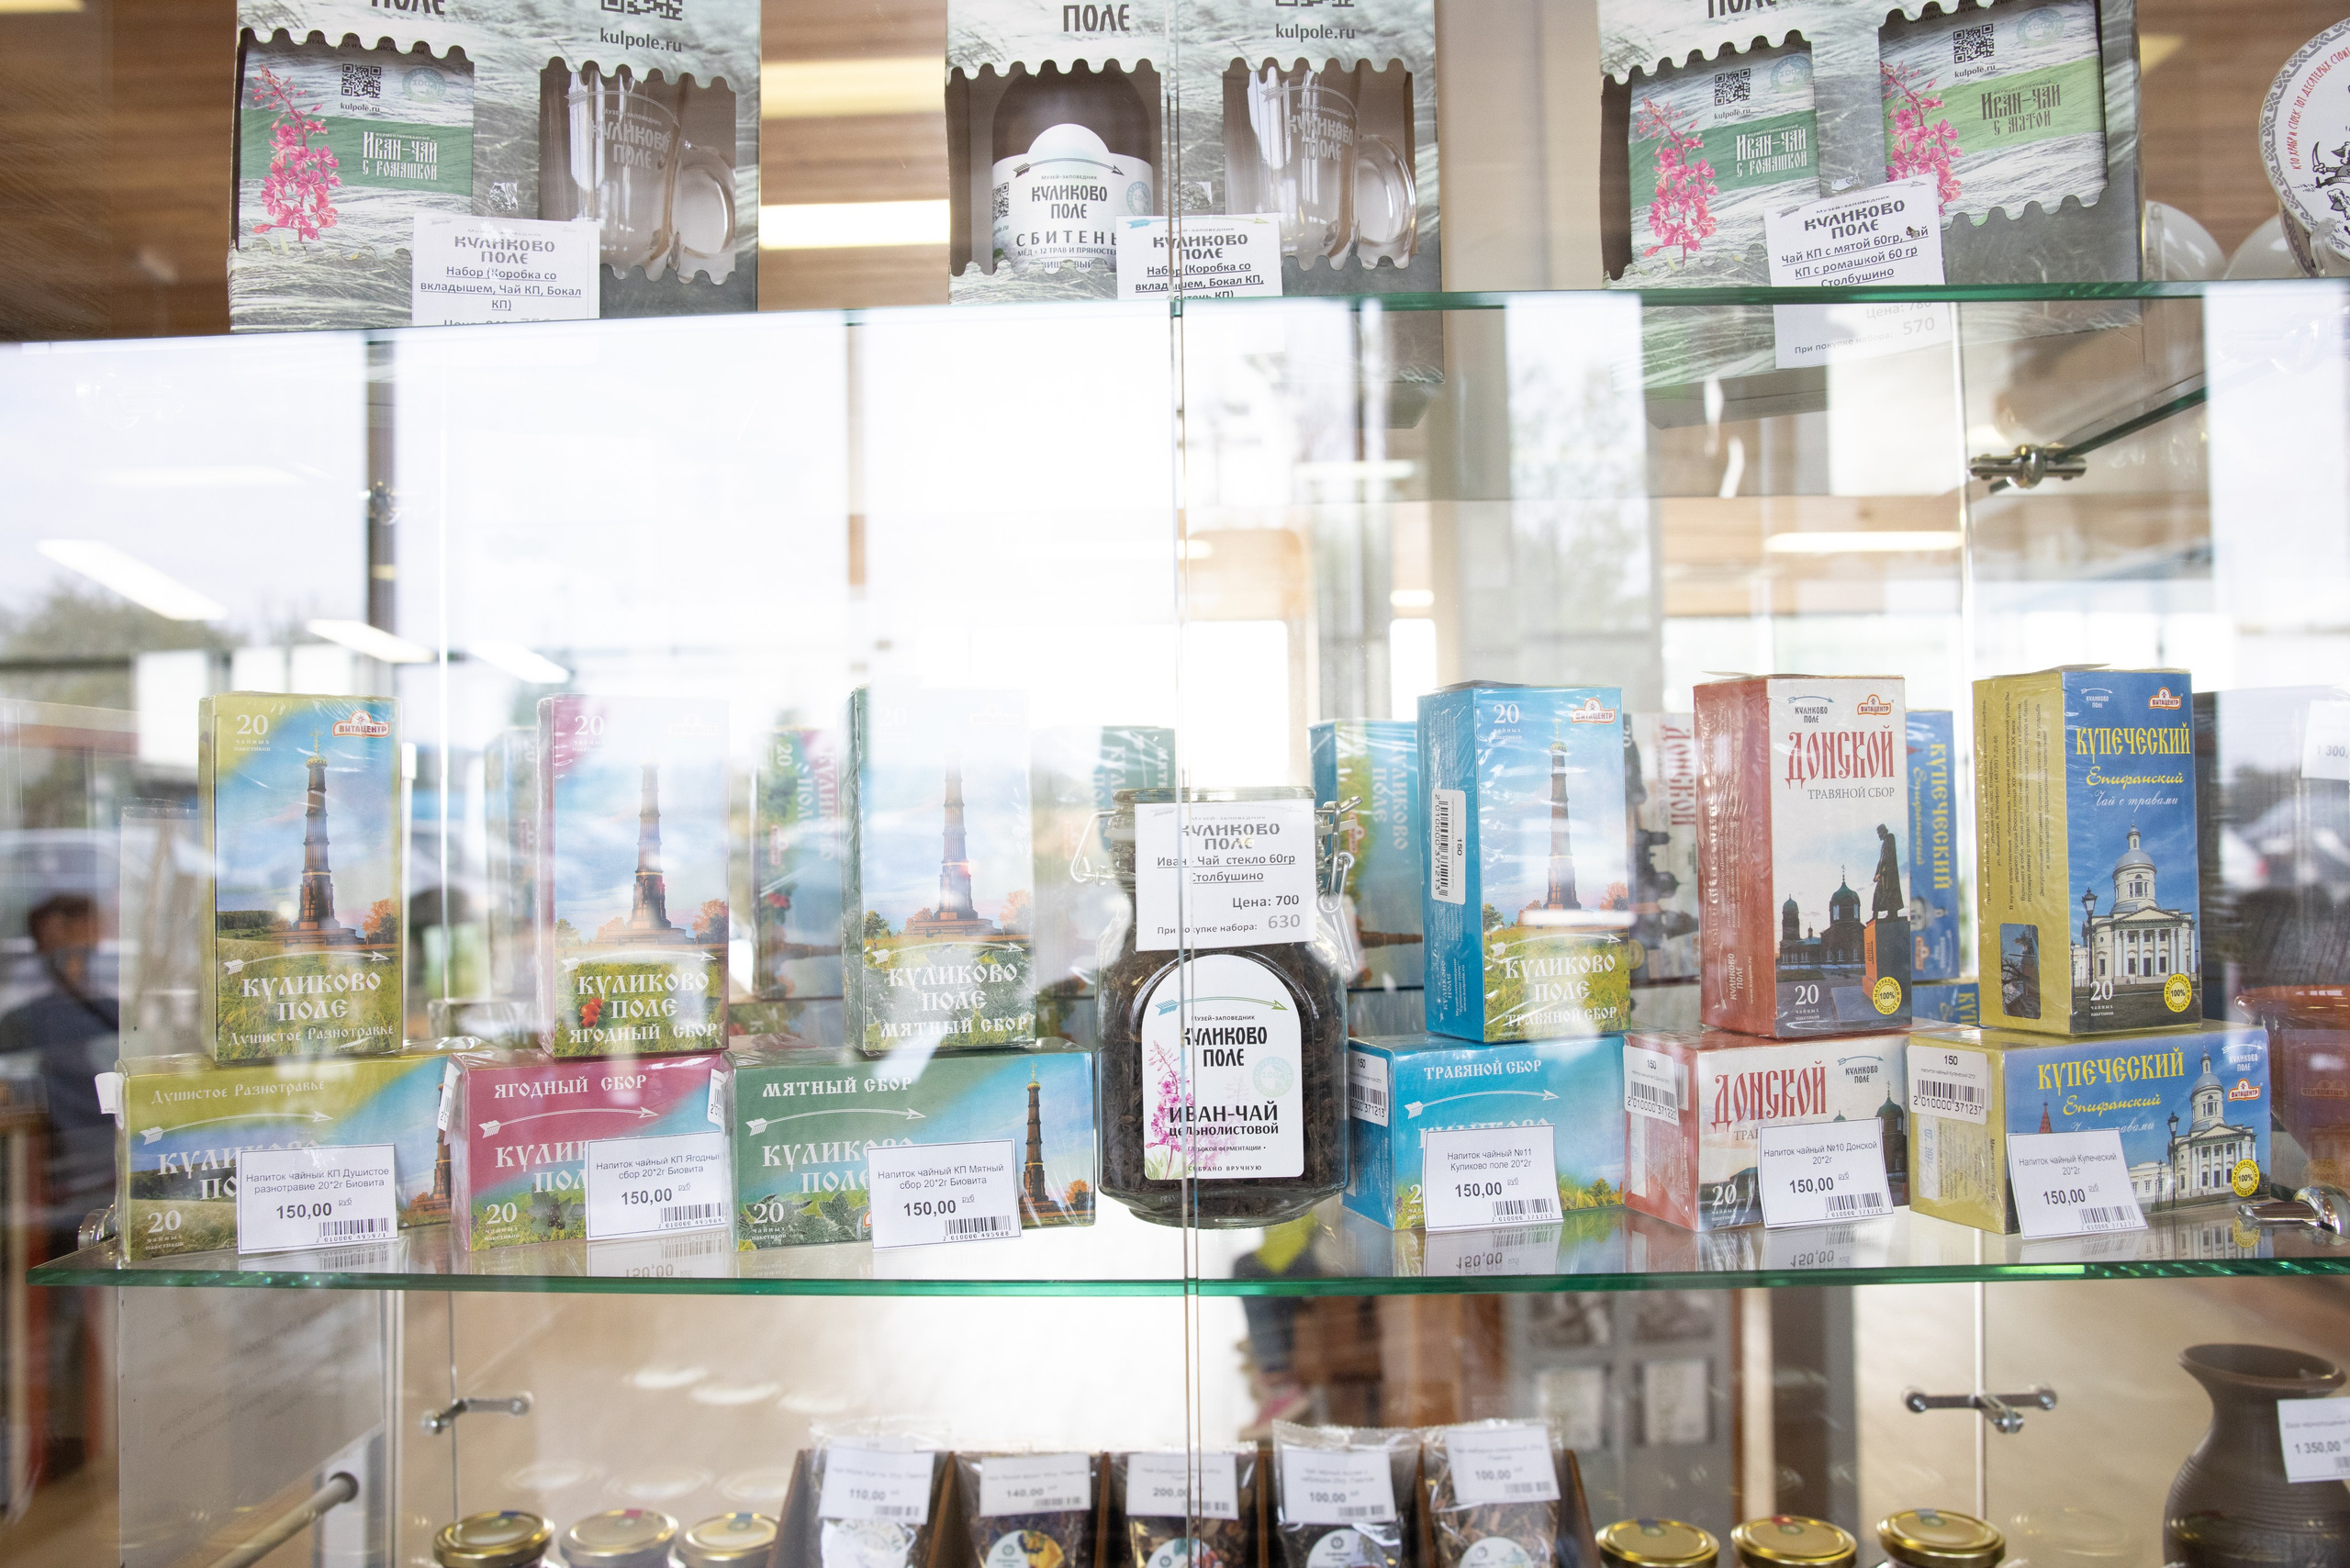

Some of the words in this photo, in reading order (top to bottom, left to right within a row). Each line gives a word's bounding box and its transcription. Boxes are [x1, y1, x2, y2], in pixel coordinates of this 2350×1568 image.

[1062, 5, 1130, 32] ПОЛЕ
[600, 28, 681, 52] kulpole.ru
[1276, 24, 1355, 42] kulpole.ru
[1954, 64, 1996, 78] kulpole.ru
[341, 103, 380, 112] kulpole.ru
[2294, 95, 2307, 107] ТОТ
[2287, 137, 2299, 156] ХРАБР
[2290, 156, 2301, 169] КТО
[1032, 185, 1107, 201] КУЛИКОВО
[1051, 204, 1087, 218] ПОЛЕ
[1804, 200, 1905, 230] КУЛИКОВО
[1831, 219, 1879, 239] ПОЛЕ
[454, 236, 555, 252] КУЛИКОВО
[1782, 253, 1803, 264] Чай
[1807, 249, 1822, 259] КП
[1834, 239, 1870, 254] мятой
[1874, 235, 1903, 246] 60гр,
[481, 252, 528, 263] ПОЛЕ
[1823, 252, 1886, 273] ромашкой
[1889, 249, 1902, 259] 60
[1906, 246, 1918, 258] гр
[446, 266, 483, 277] Набор
[544, 272, 556, 280] со
[1185, 264, 1235, 274] (Коробка
[1821, 268, 1894, 286] Столбушино
[420, 283, 496, 294] вкладышем,
[499, 285, 520, 295] Чай
[525, 286, 543, 296] КП,
[547, 286, 581, 296] Бокал
[1209, 278, 1242, 286] Бокал
[1246, 275, 1264, 284] КП,
[492, 300, 511, 310] КП)
[1903, 318, 1935, 336] 570
[1494, 704, 1519, 724] 20
[1795, 706, 1829, 715] КУЛИКОВО
[1860, 705, 1890, 713] ВИТАЦЕНТР
[237, 714, 268, 734] 20
[1804, 714, 1819, 723] ПОЛЕ
[339, 724, 387, 734] ВИТАЦЕНТР
[2076, 722, 2190, 764] КУПЕЧЕСКИЙ
[1785, 725, 1895, 790] ДОНСКОЙ
[2087, 767, 2185, 788] Епифанский
[1807, 786, 1865, 801] ТРАВЯНОЙ
[1868, 786, 1895, 798] СБОР
[2128, 795, 2178, 812] травами
[1197, 856, 1219, 865] Чай
[1226, 856, 1266, 865] стекло
[1269, 854, 1295, 865] 60гр
[1232, 896, 1271, 909] Цена:
[1276, 895, 1300, 906] 700
[1220, 924, 1258, 933] набора:
[1268, 914, 1300, 929] 630
[889, 962, 1017, 991] КУЛИКОВО
[1505, 954, 1616, 984] КУЛИКОВО
[241, 971, 381, 1001] КУЛИКОВО
[578, 971, 709, 1000] КУЛИКОВО
[1534, 981, 1590, 1002] ПОЛЕ
[1795, 984, 1819, 1005] 20
[2089, 980, 2113, 1002] 20
[922, 990, 988, 1012] ПОЛЕ
[1880, 991, 1895, 1000] 100%
[277, 998, 348, 1023] ПОЛЕ
[611, 997, 678, 1019] ПОЛЕ
[1505, 1008, 1580, 1027] ТРАВЯНОЙ
[1582, 1005, 1617, 1022] СБОР
[570, 1022, 660, 1044] ЯГОДНЫЙ
[672, 1023, 717, 1038] СБОР
[880, 1017, 973, 1038] МЯТНЫЙ
[1203, 1048, 1244, 1067] ПОЛЕ
[1647, 1058, 1657, 1070] 150
[1944, 1056, 1958, 1065] 150
[2229, 1053, 2258, 1063] КУЛИКОВО
[1424, 1058, 1503, 1081] ТРАВЯНОЙ
[1506, 1059, 1542, 1076] СБОР
[1845, 1064, 1879, 1076] КУЛИКОВО
[2037, 1046, 2185, 1097] КУПЕЧЕСКИЙ
[2237, 1063, 2251, 1071] ПОЛЕ
[494, 1076, 588, 1098] ЯГОДНЫЙ
[600, 1074, 647, 1092] СБОР
[762, 1076, 856, 1098] МЯТНЫЙ
[864, 1076, 912, 1095] СБОР
[1854, 1074, 1870, 1083] ПОЛЕ
[1710, 1059, 1828, 1135] ДОНСКОЙ
[2232, 1090, 2257, 1098] ВИТАЦЕНТР
[1169, 1102, 1278, 1124] ИВАН-ЧАЙ
[1921, 1096, 1952, 1111] 010000
[1955, 1102, 1982, 1116] 371237
[2063, 1094, 2162, 1117] Епифанский
[1447, 1150, 1480, 1160] Напиток
[1483, 1148, 1513, 1158] чайный
[1514, 1148, 1532, 1157] №11
[1763, 1148, 1795, 1158] Напиток
[1796, 1146, 1825, 1155] чайный
[1827, 1144, 1844, 1152] №10
[1846, 1141, 1877, 1152] Донской
[2078, 1152, 2117, 1163] Купеческий
[596, 1160, 632, 1170] Напиток
[635, 1157, 668, 1167] чайный
[671, 1155, 684, 1163] КП
[878, 1169, 916, 1180] Напиток
[918, 1166, 952, 1177] чайный
[955, 1166, 968, 1175] КП
[969, 1163, 1004, 1174] Мятный
[1450, 1161, 1487, 1171] Куликово
[1490, 1161, 1509, 1170] поле
[246, 1173, 286, 1182] Напиток
[289, 1170, 325, 1182] чайный
[328, 1170, 341, 1179] КП
[343, 1168, 389, 1180] Душистое
[619, 1171, 640, 1181] сбор
[668, 1165, 704, 1174] Биовита
[254, 1182, 315, 1195] разнотравие
[346, 1178, 385, 1188] Биовита
[621, 1188, 672, 1205] 150,00
[678, 1182, 691, 1192] руб
[1455, 1182, 1503, 1199] 150,00
[276, 1202, 332, 1220] 150,00
[338, 1197, 352, 1206] руб
[903, 1199, 957, 1218] 150,00
[962, 1194, 975, 1204] руб
[2305, 1441, 2341, 1454] 350,00
